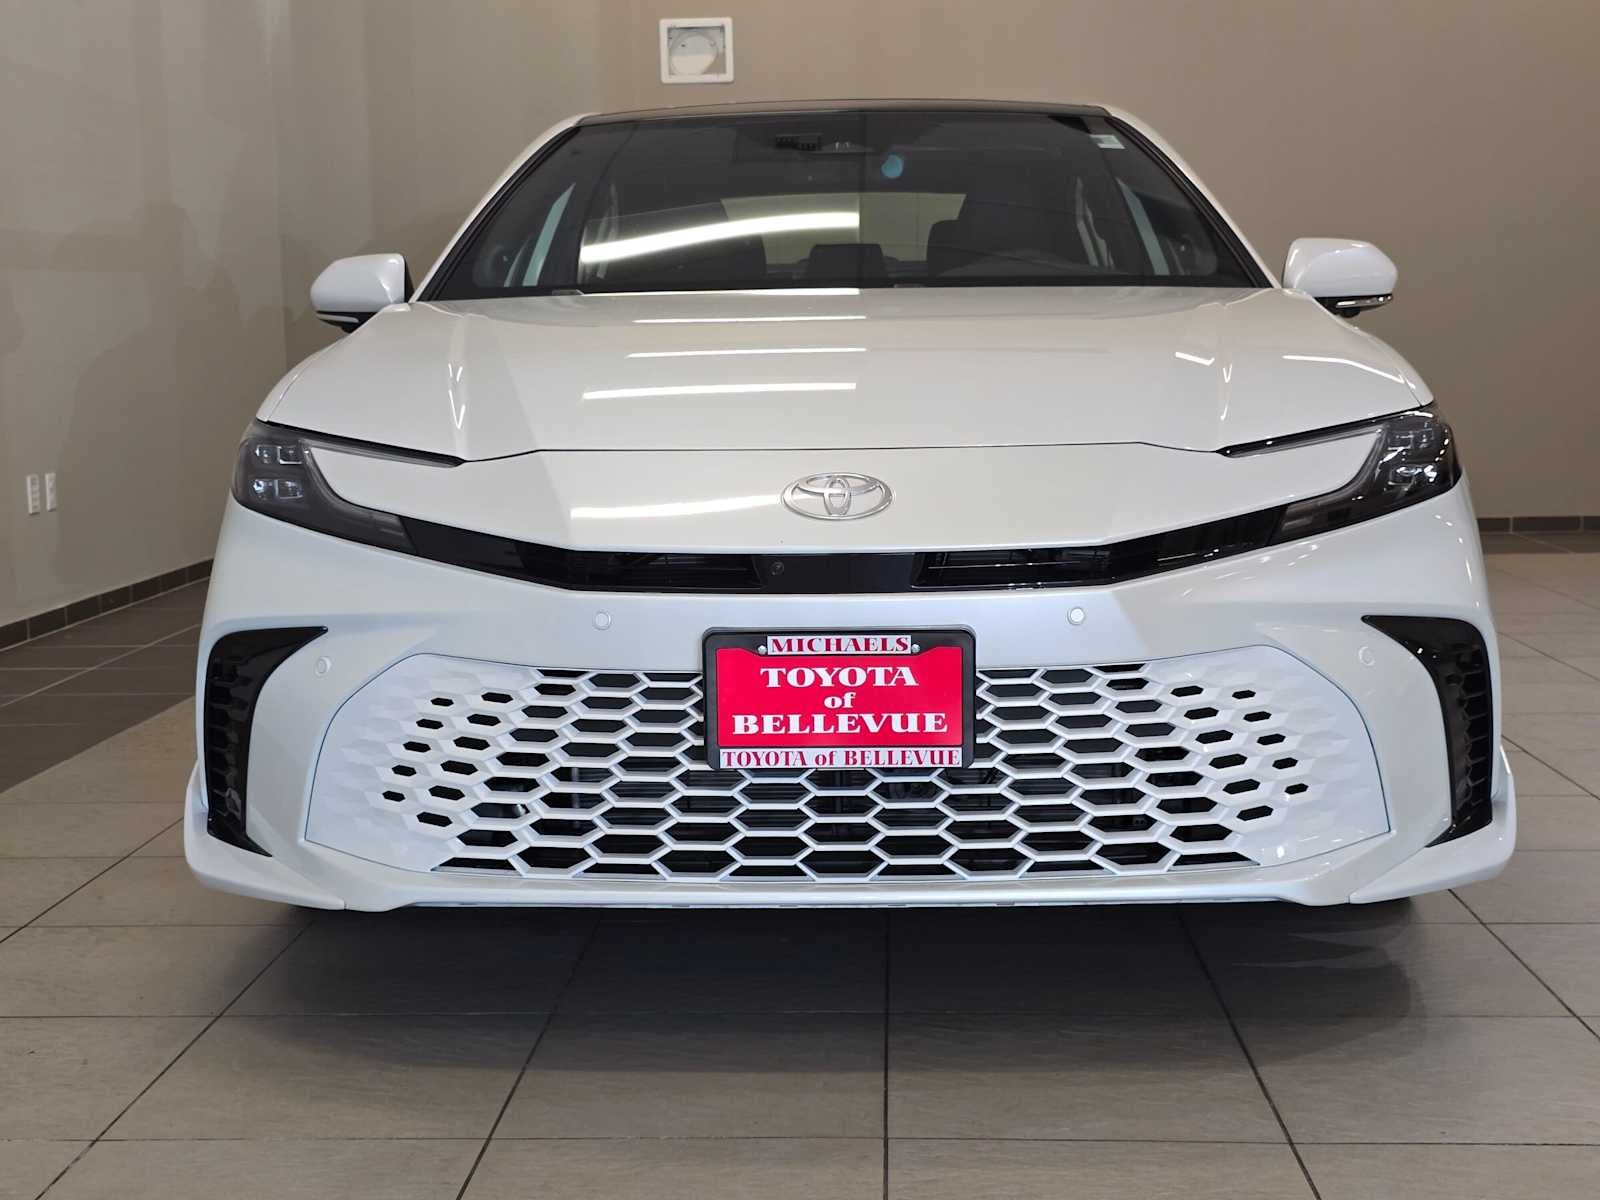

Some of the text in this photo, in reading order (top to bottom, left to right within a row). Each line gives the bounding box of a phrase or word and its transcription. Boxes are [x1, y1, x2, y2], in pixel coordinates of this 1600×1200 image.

[771, 637, 909, 653] MICHAELS
[760, 666, 920, 688] TOYOTA
[823, 692, 857, 709] of
[732, 712, 949, 735] BELLEVUE
[722, 750, 960, 767] TOYOTA of BELLEVUE
